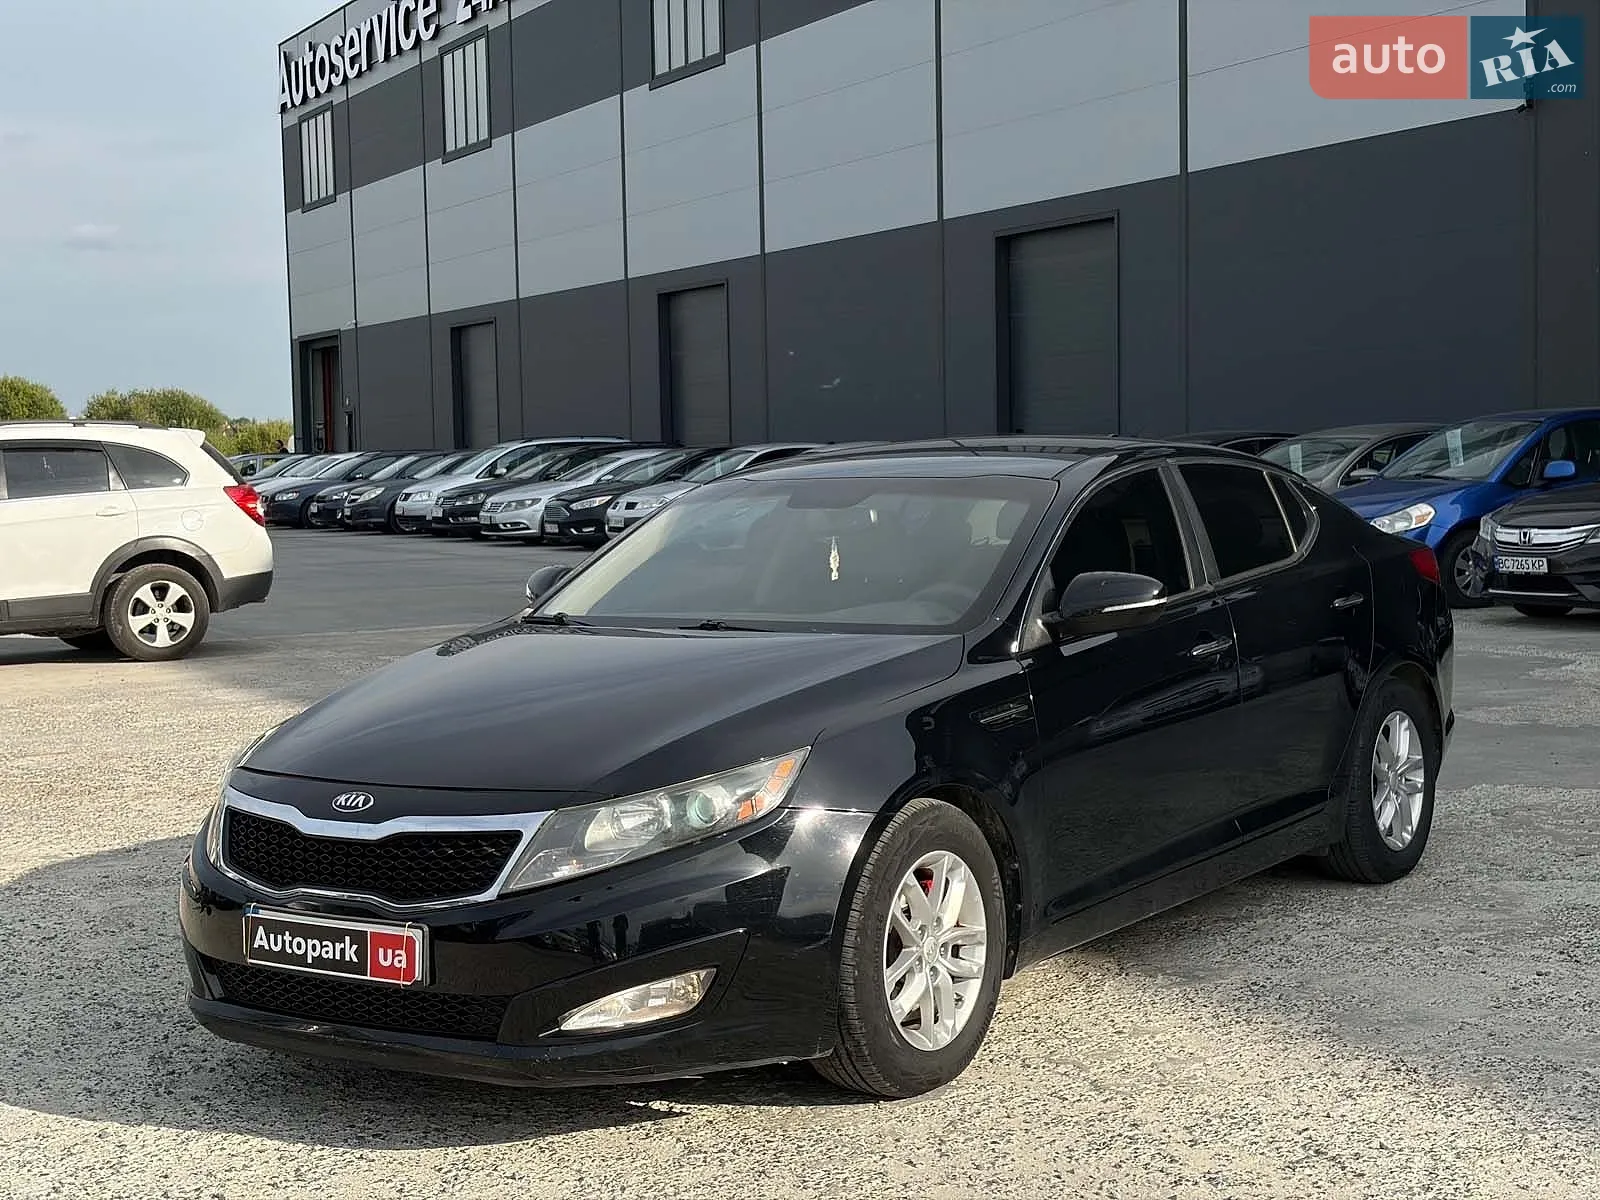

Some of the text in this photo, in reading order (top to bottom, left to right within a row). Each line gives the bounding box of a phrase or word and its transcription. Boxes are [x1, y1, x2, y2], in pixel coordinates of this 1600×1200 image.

[278, 0, 438, 113] Autoservice
[336, 793, 366, 808] KIA
[253, 925, 408, 969] Autopark ua
